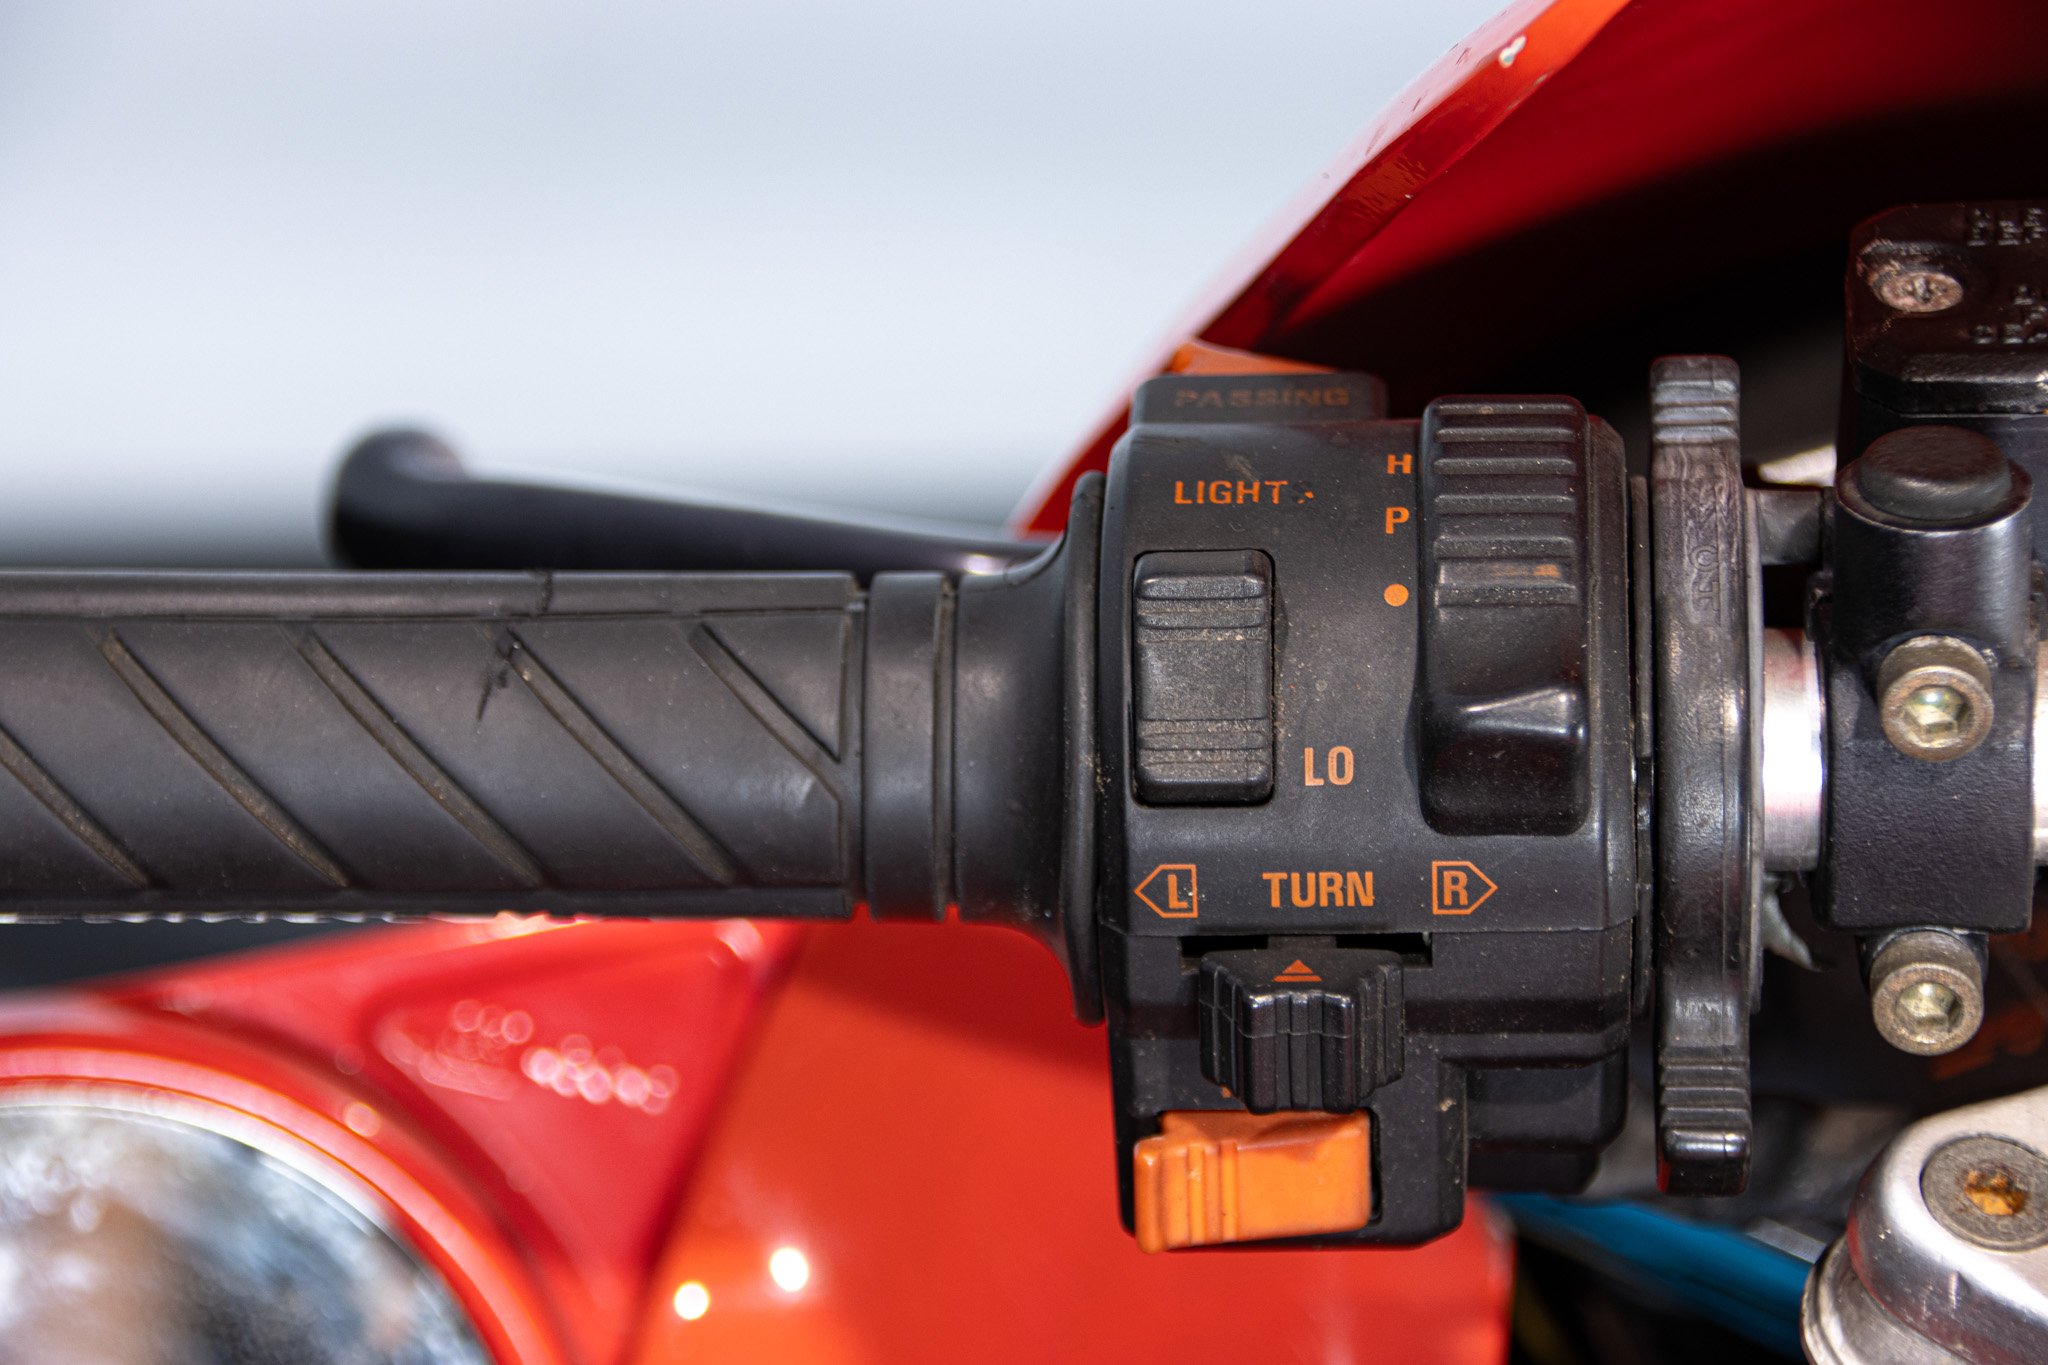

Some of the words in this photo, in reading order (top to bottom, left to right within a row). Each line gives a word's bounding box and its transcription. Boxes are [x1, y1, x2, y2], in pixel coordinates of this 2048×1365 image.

[1174, 387, 1350, 408] PASSING
[1387, 453, 1413, 474] H
[1174, 480, 1314, 504] LIGHT
[1385, 506, 1410, 534] P
[1304, 746, 1355, 786] LO
[1167, 874, 1189, 909] L
[1262, 871, 1376, 908] TURN
[1443, 870, 1469, 906] R
